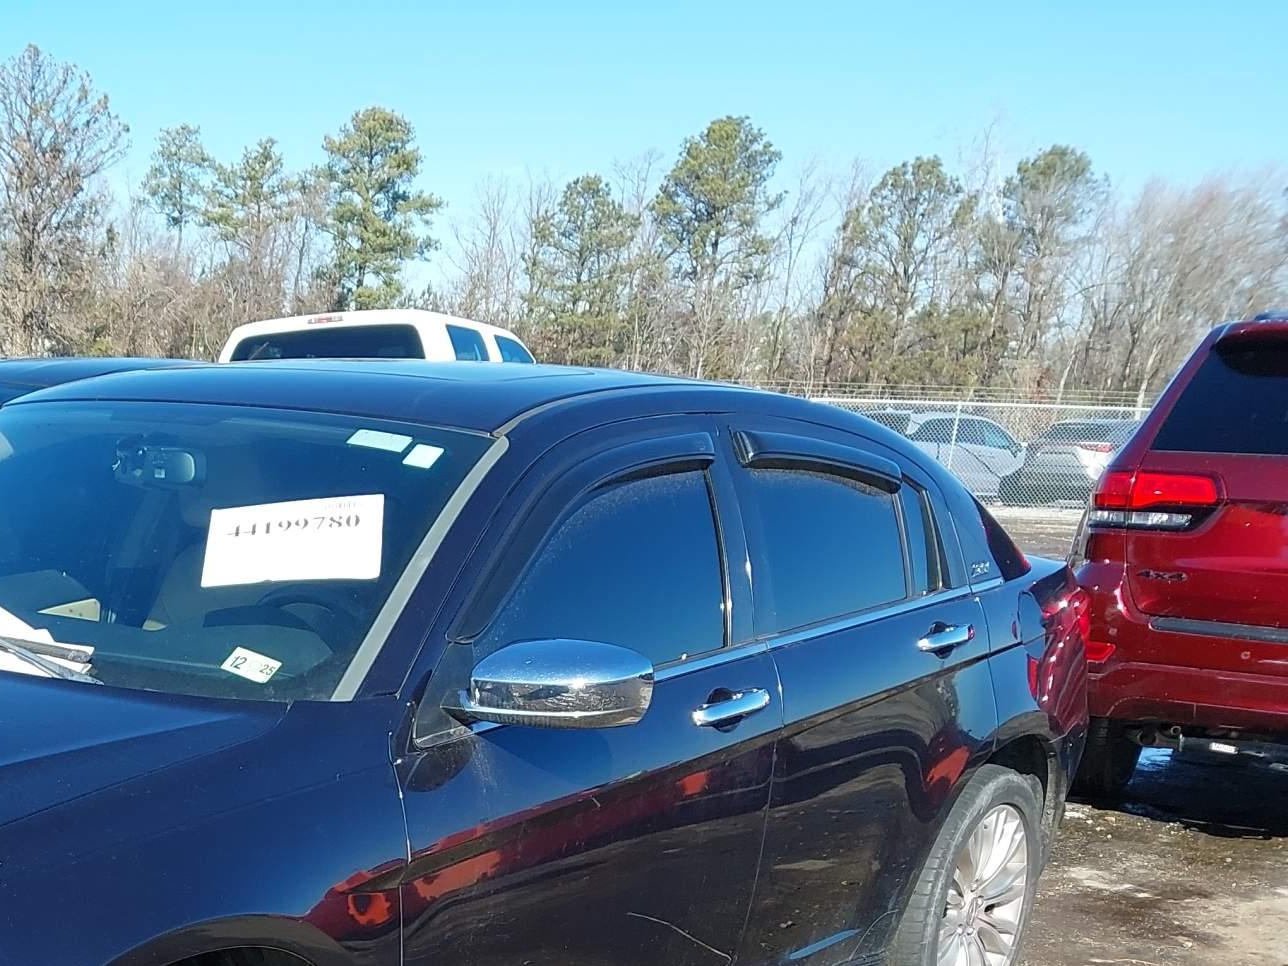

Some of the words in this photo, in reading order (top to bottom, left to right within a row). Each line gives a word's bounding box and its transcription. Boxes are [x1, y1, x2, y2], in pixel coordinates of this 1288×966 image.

[226, 514, 360, 537] 44199780
[230, 655, 248, 670] 12
[259, 663, 276, 676] 25
